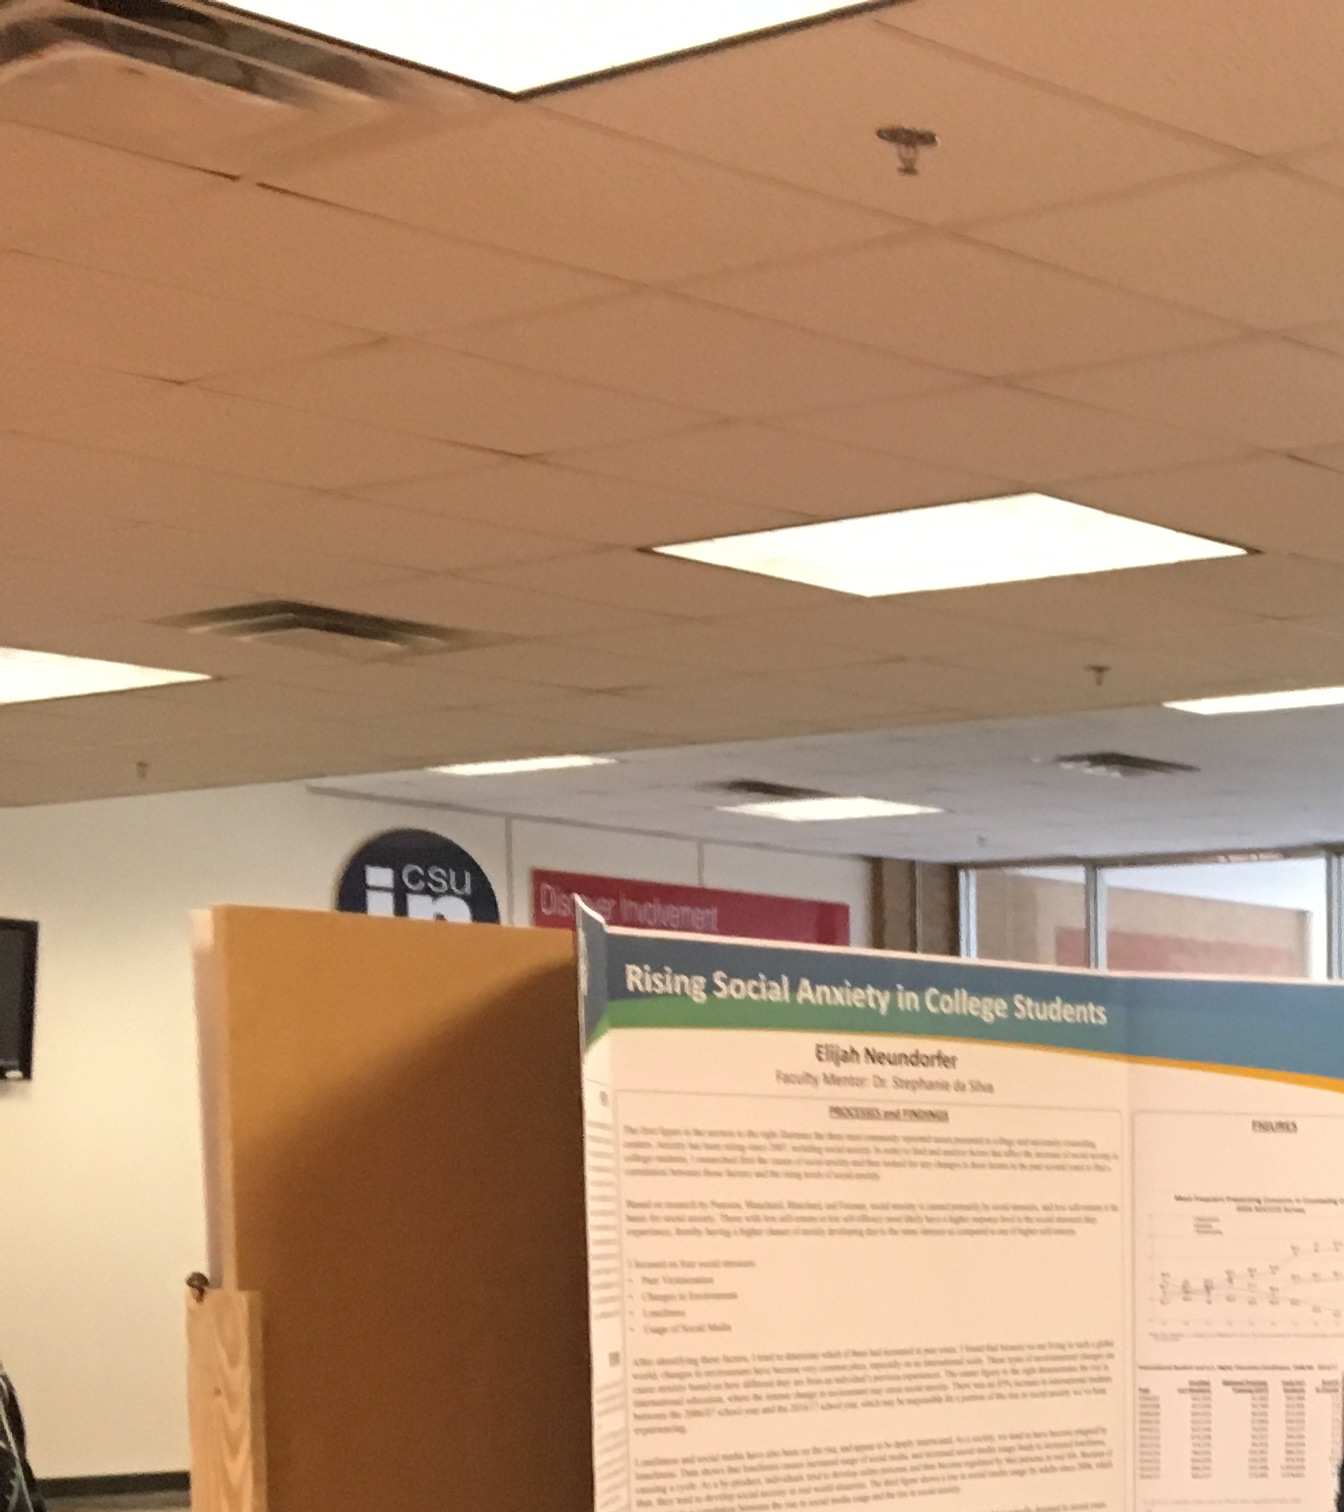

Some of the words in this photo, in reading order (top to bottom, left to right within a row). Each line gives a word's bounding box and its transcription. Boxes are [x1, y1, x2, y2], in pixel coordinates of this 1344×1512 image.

[402, 864, 472, 896] CSU
[625, 963, 708, 1004] Rising
[712, 970, 791, 1003] Social
[797, 976, 891, 1017] Anxiety
[896, 984, 920, 1012] in
[925, 986, 1009, 1024] College
[1013, 993, 1108, 1025] Students
[815, 1042, 860, 1068] Elijah
[863, 1046, 959, 1070] Neundorfer
[775, 1068, 818, 1088] Faculty
